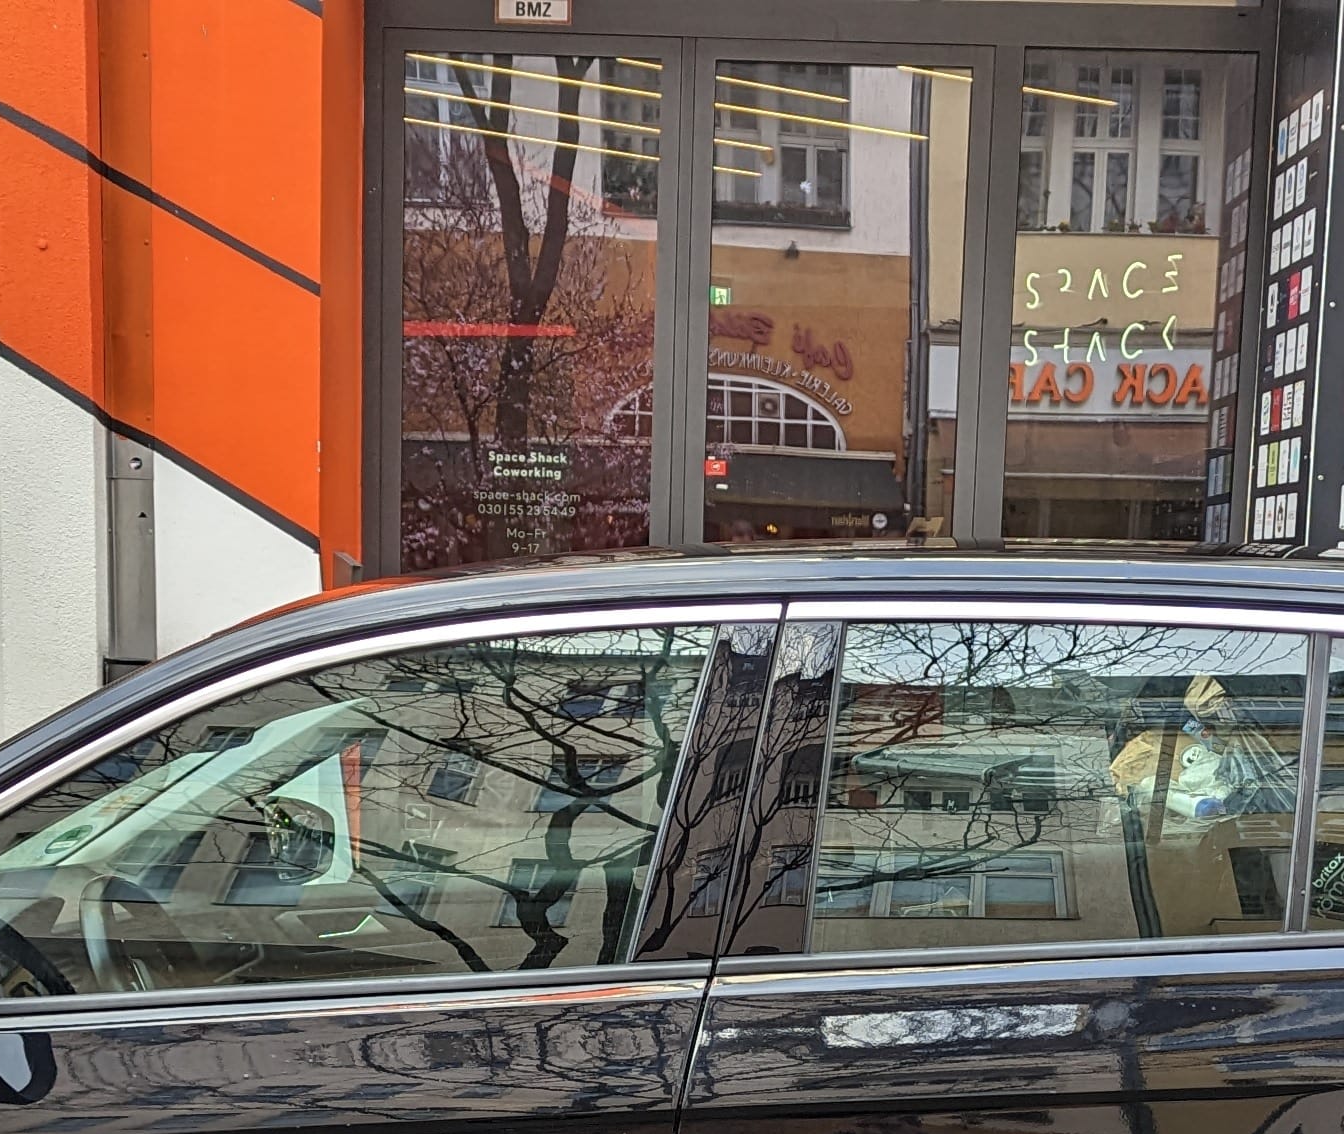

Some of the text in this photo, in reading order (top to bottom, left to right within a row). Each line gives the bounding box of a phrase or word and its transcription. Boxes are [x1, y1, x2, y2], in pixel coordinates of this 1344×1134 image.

[516, 2, 552, 17] BMZ
[488, 451, 567, 464] Space Shack
[493, 466, 562, 480] Coworking
[473, 490, 581, 502] space-shack.com
[560, 506, 576, 516] 49
